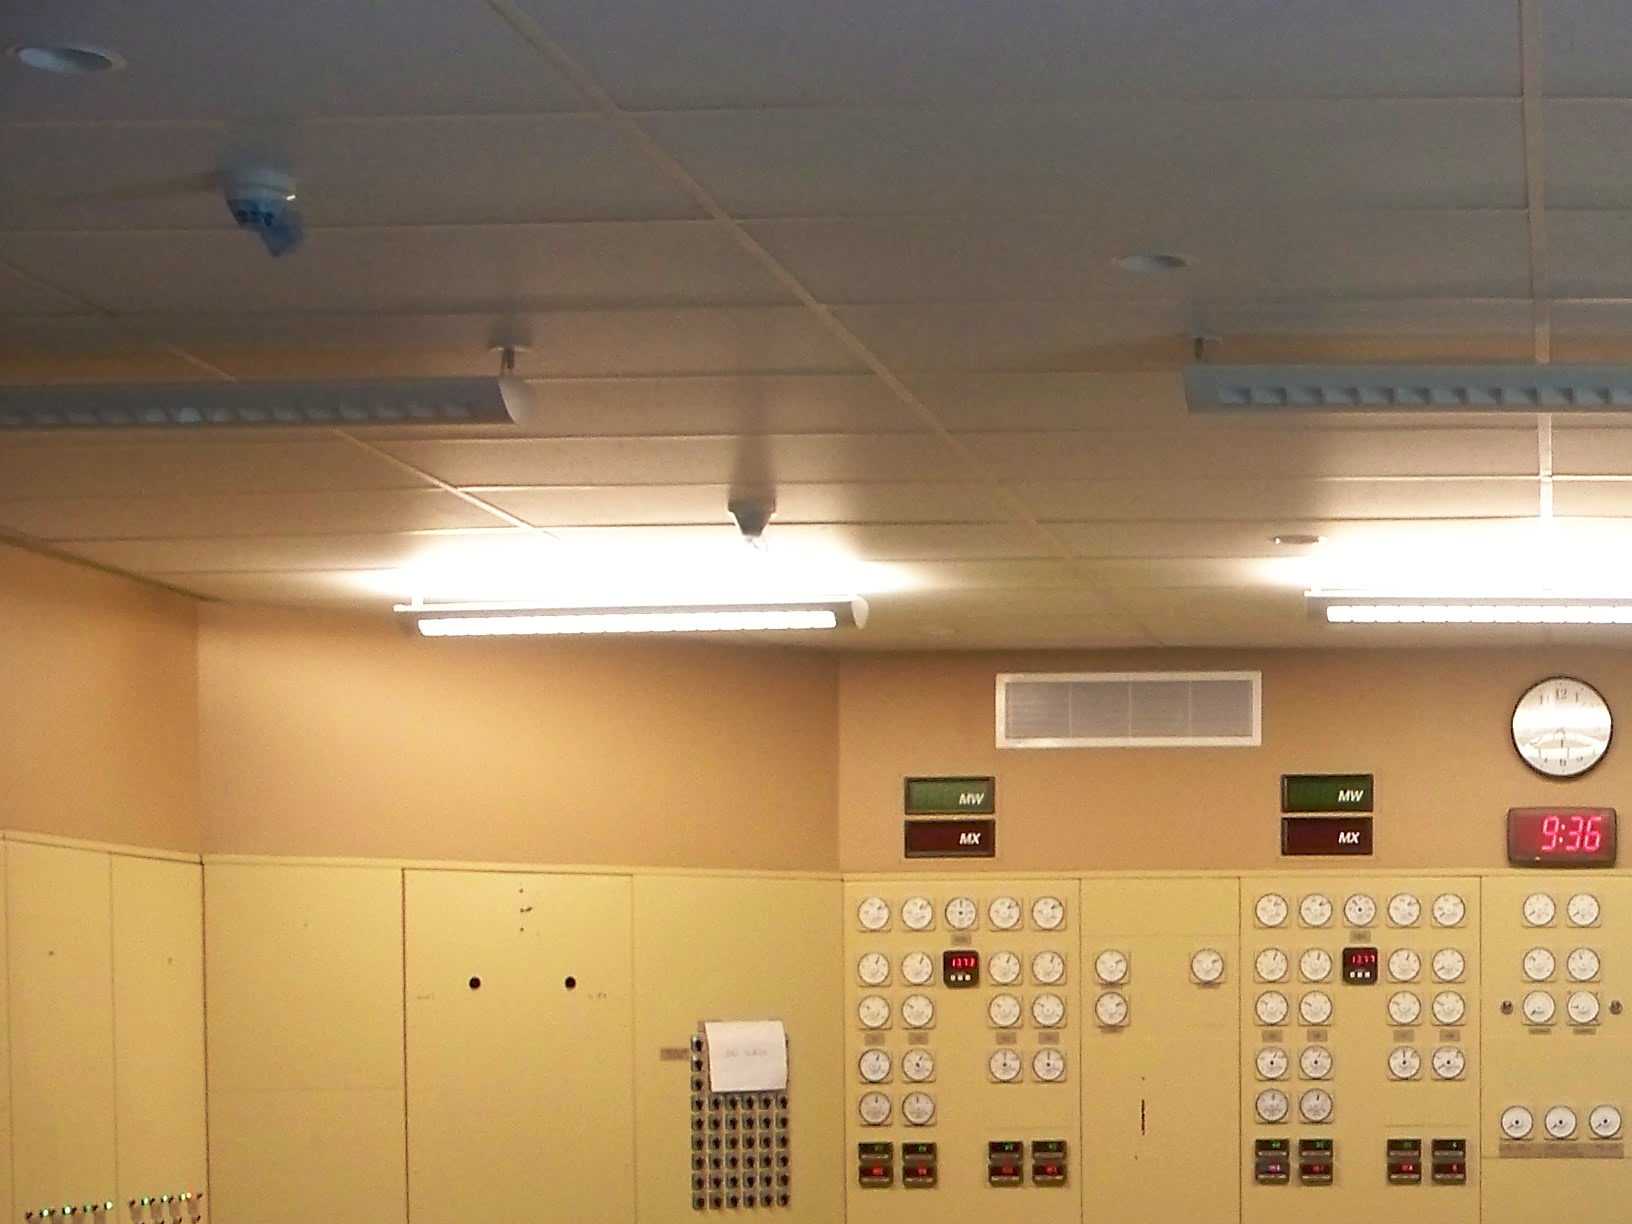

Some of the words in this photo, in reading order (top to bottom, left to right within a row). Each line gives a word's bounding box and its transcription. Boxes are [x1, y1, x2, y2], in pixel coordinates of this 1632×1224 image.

[1555, 688, 1568, 700] 12
[959, 793, 984, 806] MW
[1338, 790, 1364, 803] MW
[959, 832, 982, 846] MX
[1338, 831, 1361, 845] MX
[1541, 815, 1602, 852] 9:36
